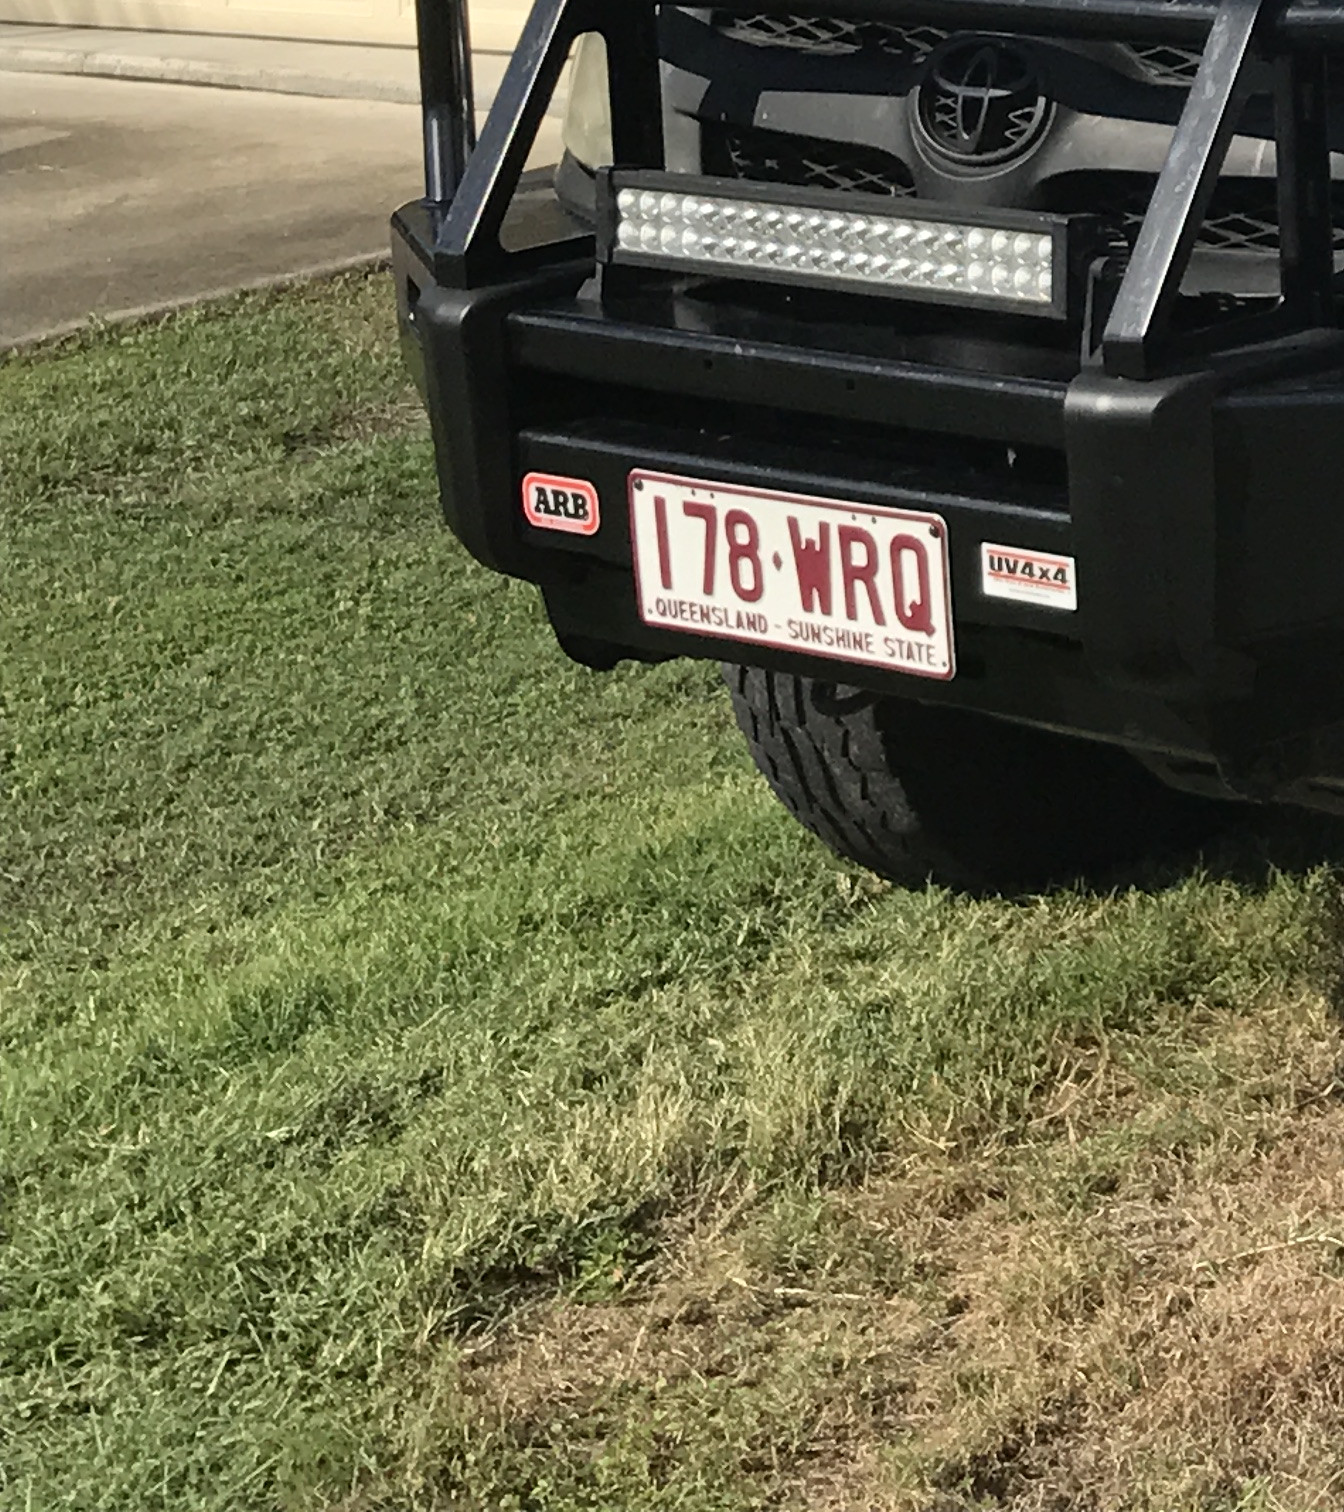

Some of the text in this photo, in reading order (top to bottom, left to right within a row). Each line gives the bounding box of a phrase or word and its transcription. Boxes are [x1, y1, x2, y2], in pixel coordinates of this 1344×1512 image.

[534, 486, 589, 521] ARB
[989, 555, 1069, 584] UV4x4
[655, 597, 769, 635] QUEENSLAND
[787, 619, 876, 654] SUNSHINE
[884, 636, 937, 667] STATE
